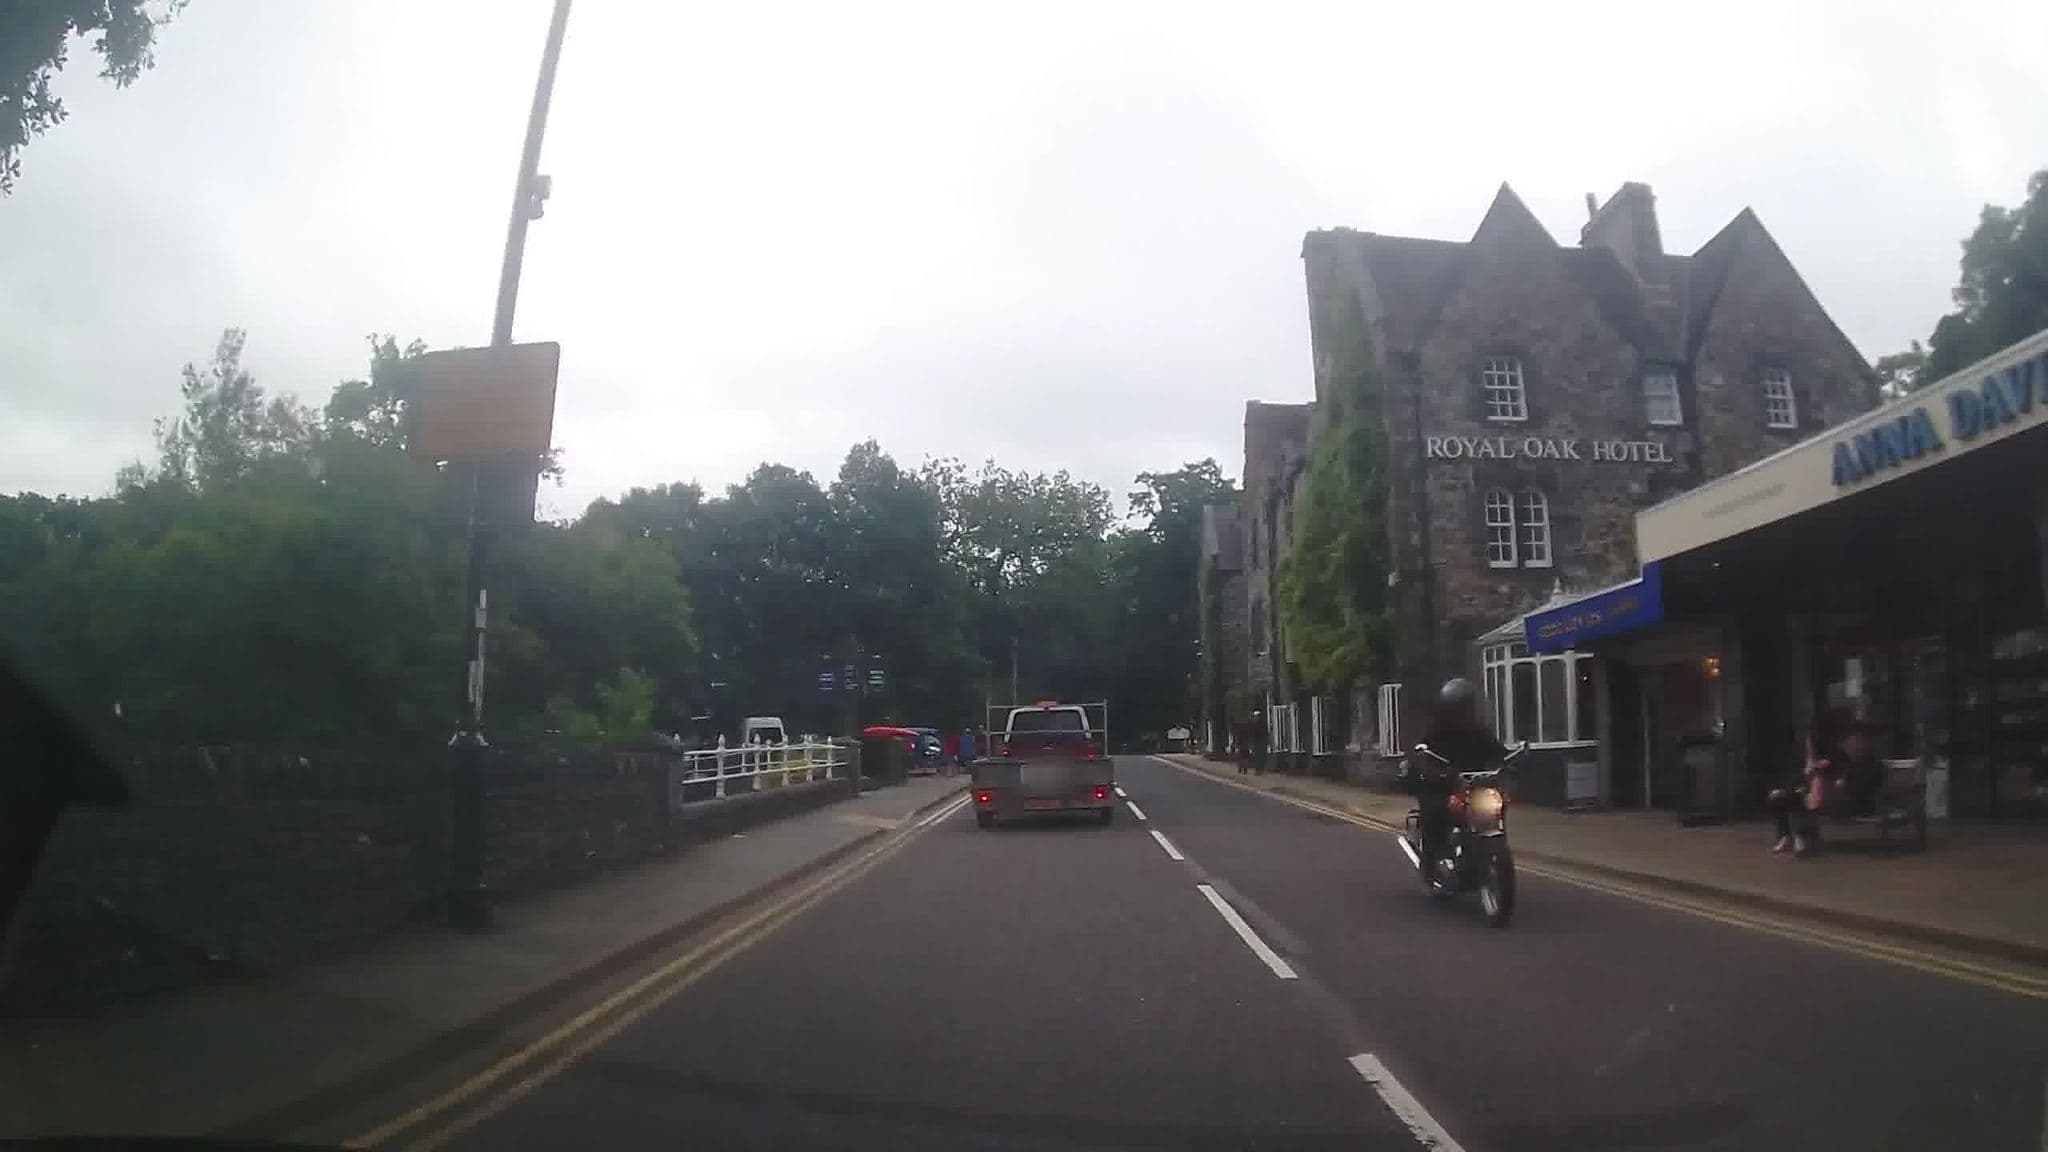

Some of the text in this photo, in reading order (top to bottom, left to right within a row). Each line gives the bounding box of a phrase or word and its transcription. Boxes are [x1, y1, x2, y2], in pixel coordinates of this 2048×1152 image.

[1427, 436, 1673, 462] ROYAL OAK HOTEL
[1832, 408, 1946, 485] ANNA
